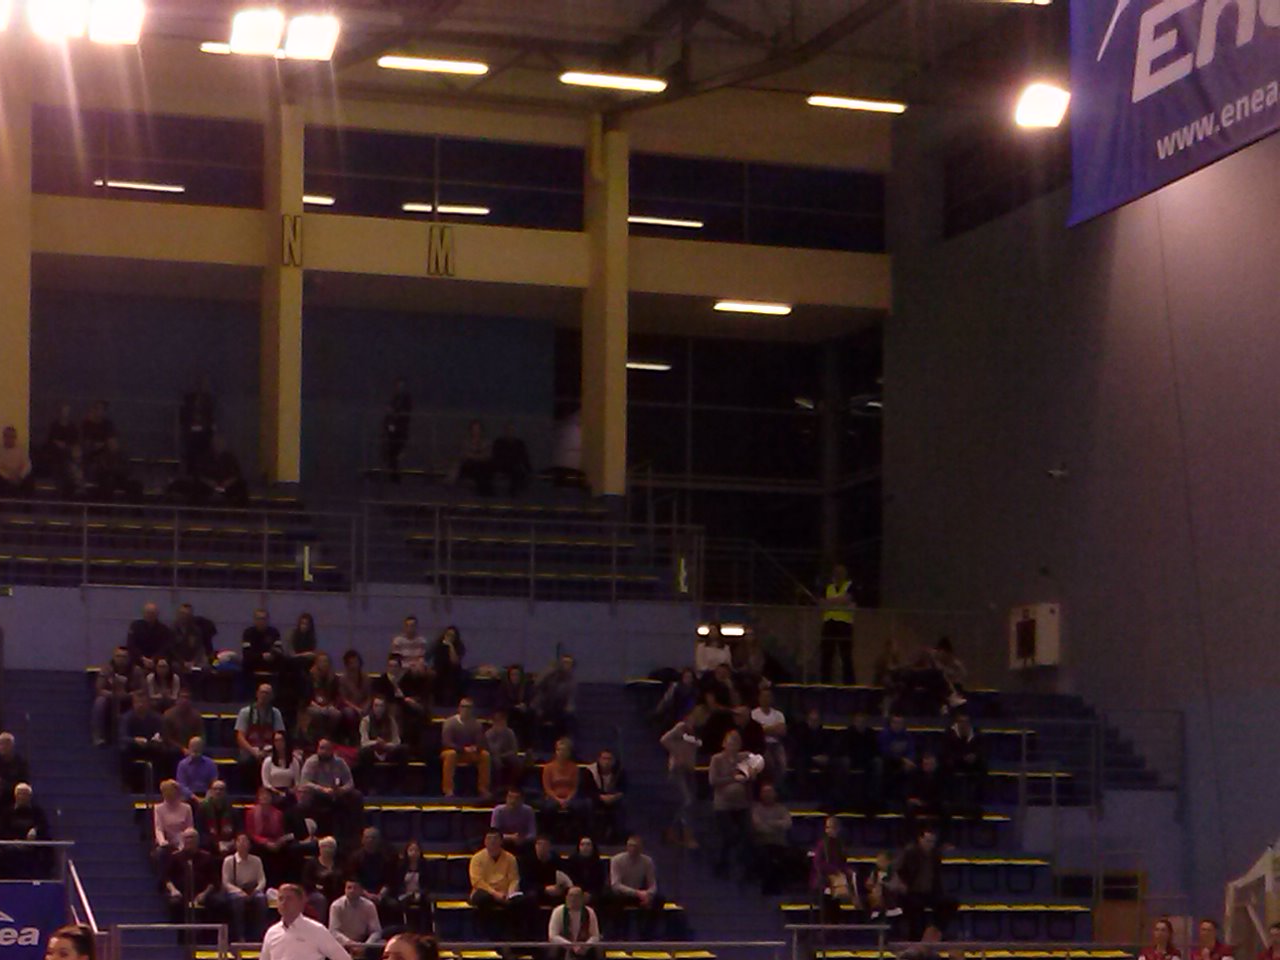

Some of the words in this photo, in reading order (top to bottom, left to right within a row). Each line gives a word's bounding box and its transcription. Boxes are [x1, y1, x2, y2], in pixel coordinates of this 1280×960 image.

[1132, 0, 1280, 103] En
[281, 215, 303, 266] N
[427, 225, 455, 277] M
